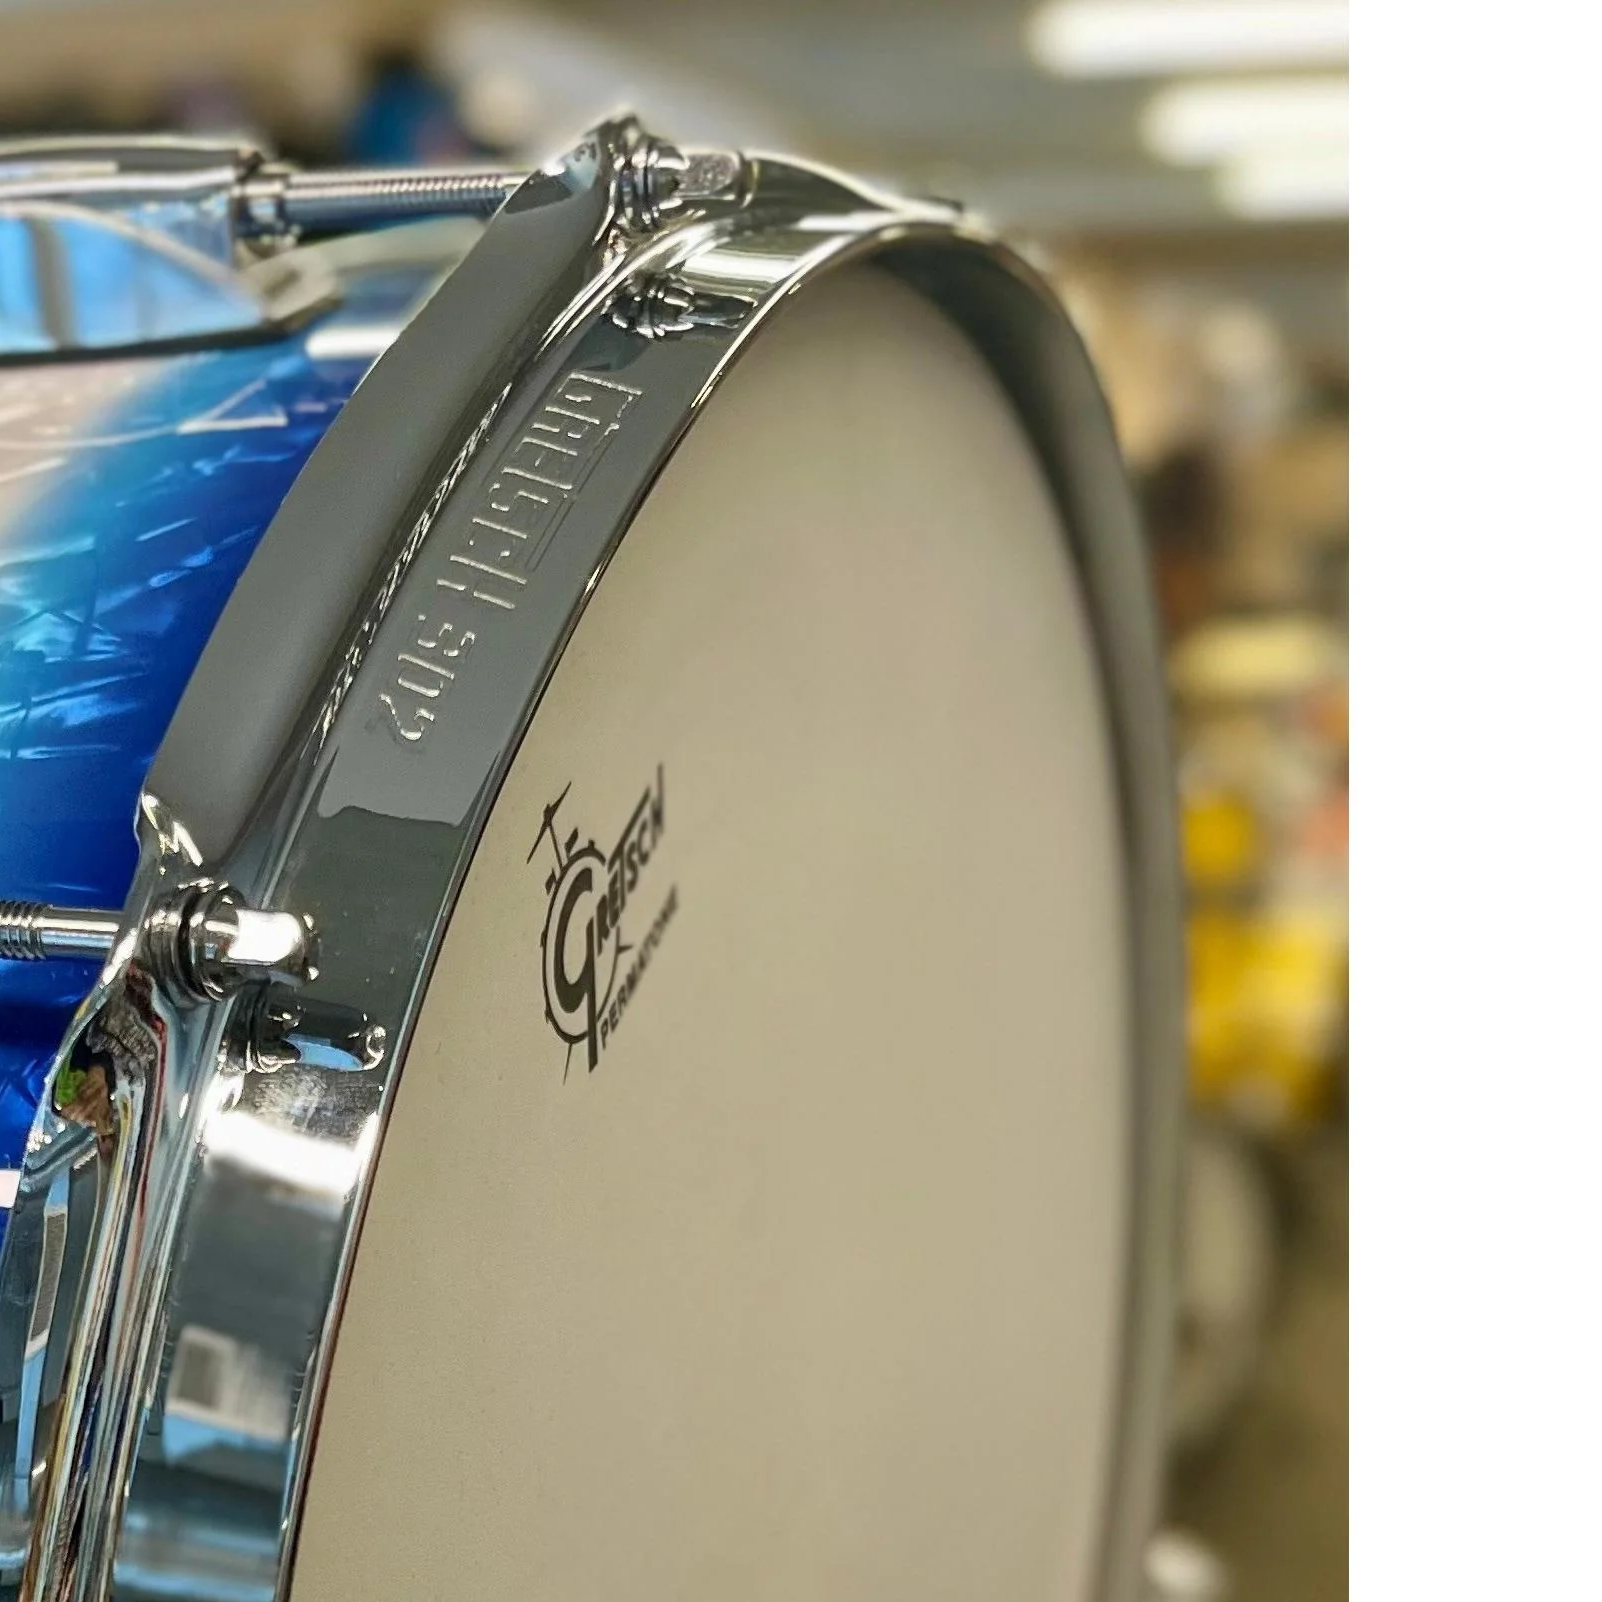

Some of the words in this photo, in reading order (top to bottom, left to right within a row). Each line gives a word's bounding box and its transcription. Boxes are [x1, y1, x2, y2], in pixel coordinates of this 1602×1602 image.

[437, 372, 643, 609] GRETSCH
[378, 613, 477, 742] 302
[554, 762, 665, 1074] GRETSCH
